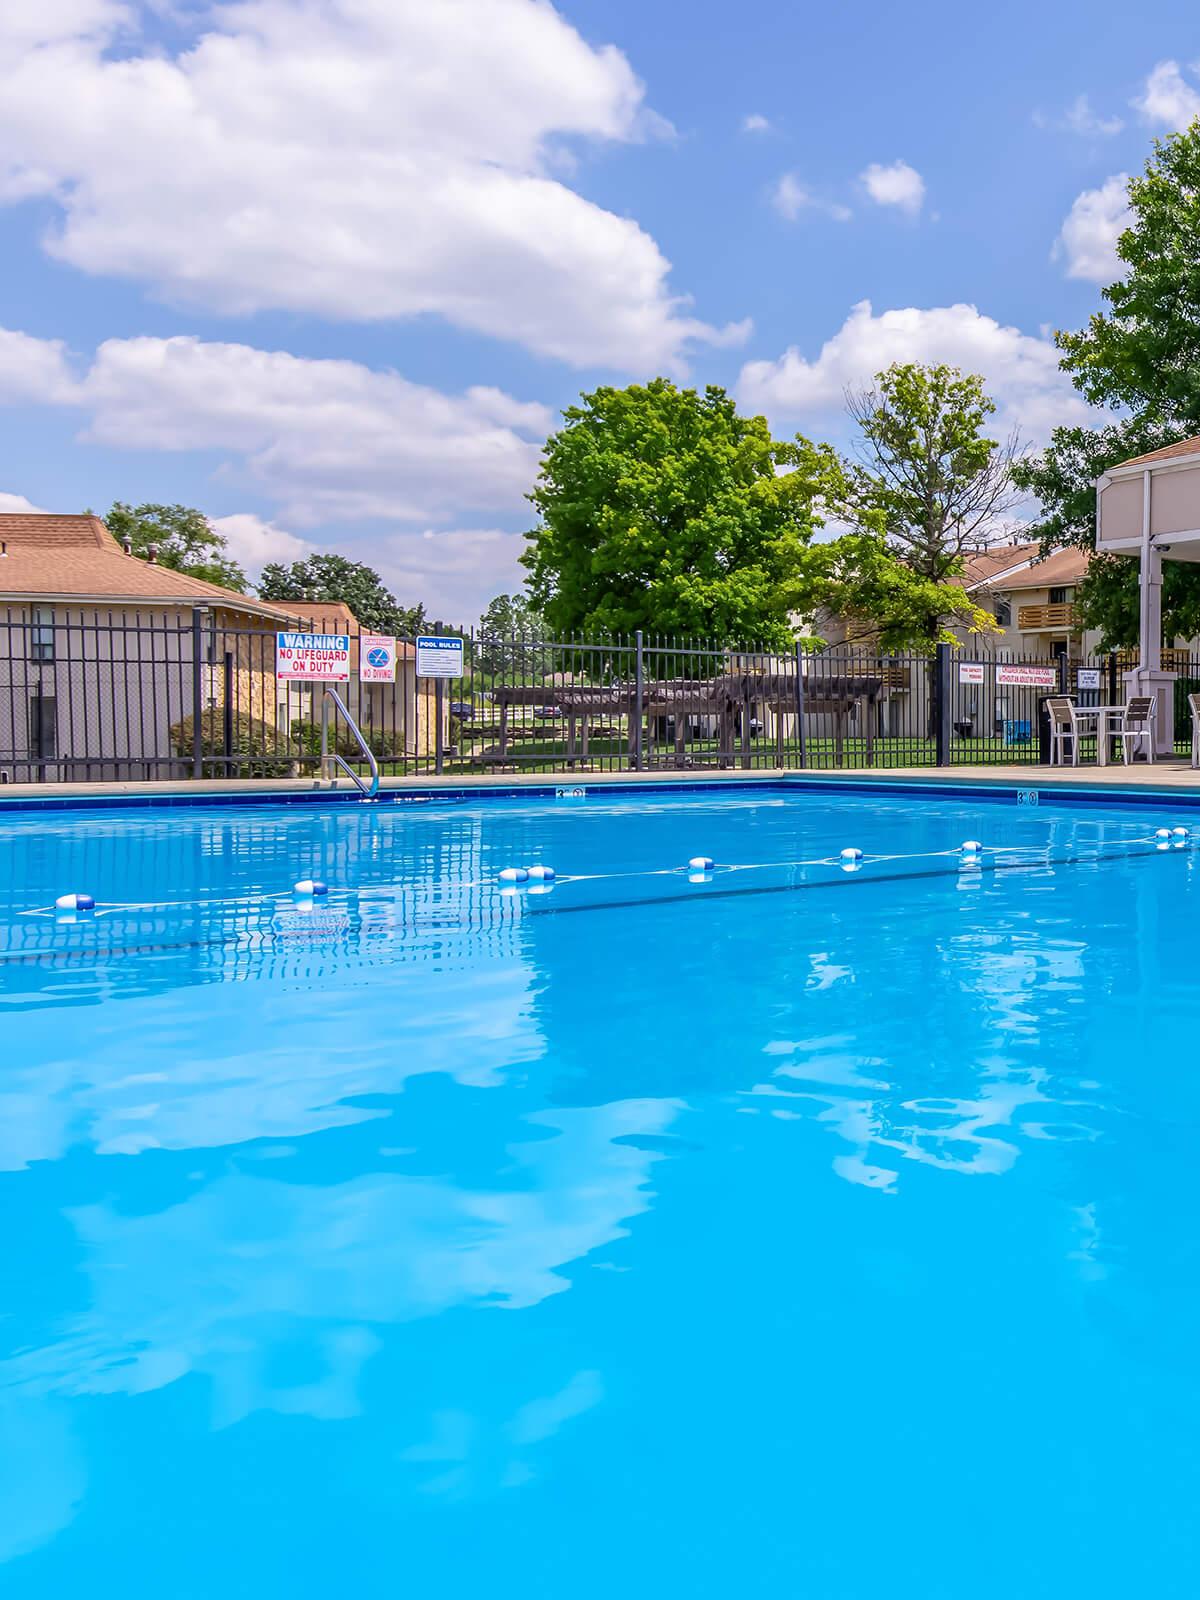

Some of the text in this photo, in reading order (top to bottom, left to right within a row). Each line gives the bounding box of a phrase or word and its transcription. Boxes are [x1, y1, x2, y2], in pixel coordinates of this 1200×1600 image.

[283, 633, 345, 650] WARNING
[419, 641, 436, 649] POOL
[279, 649, 347, 662] NO LIFEGUARD
[292, 660, 334, 673] ON DUTY
